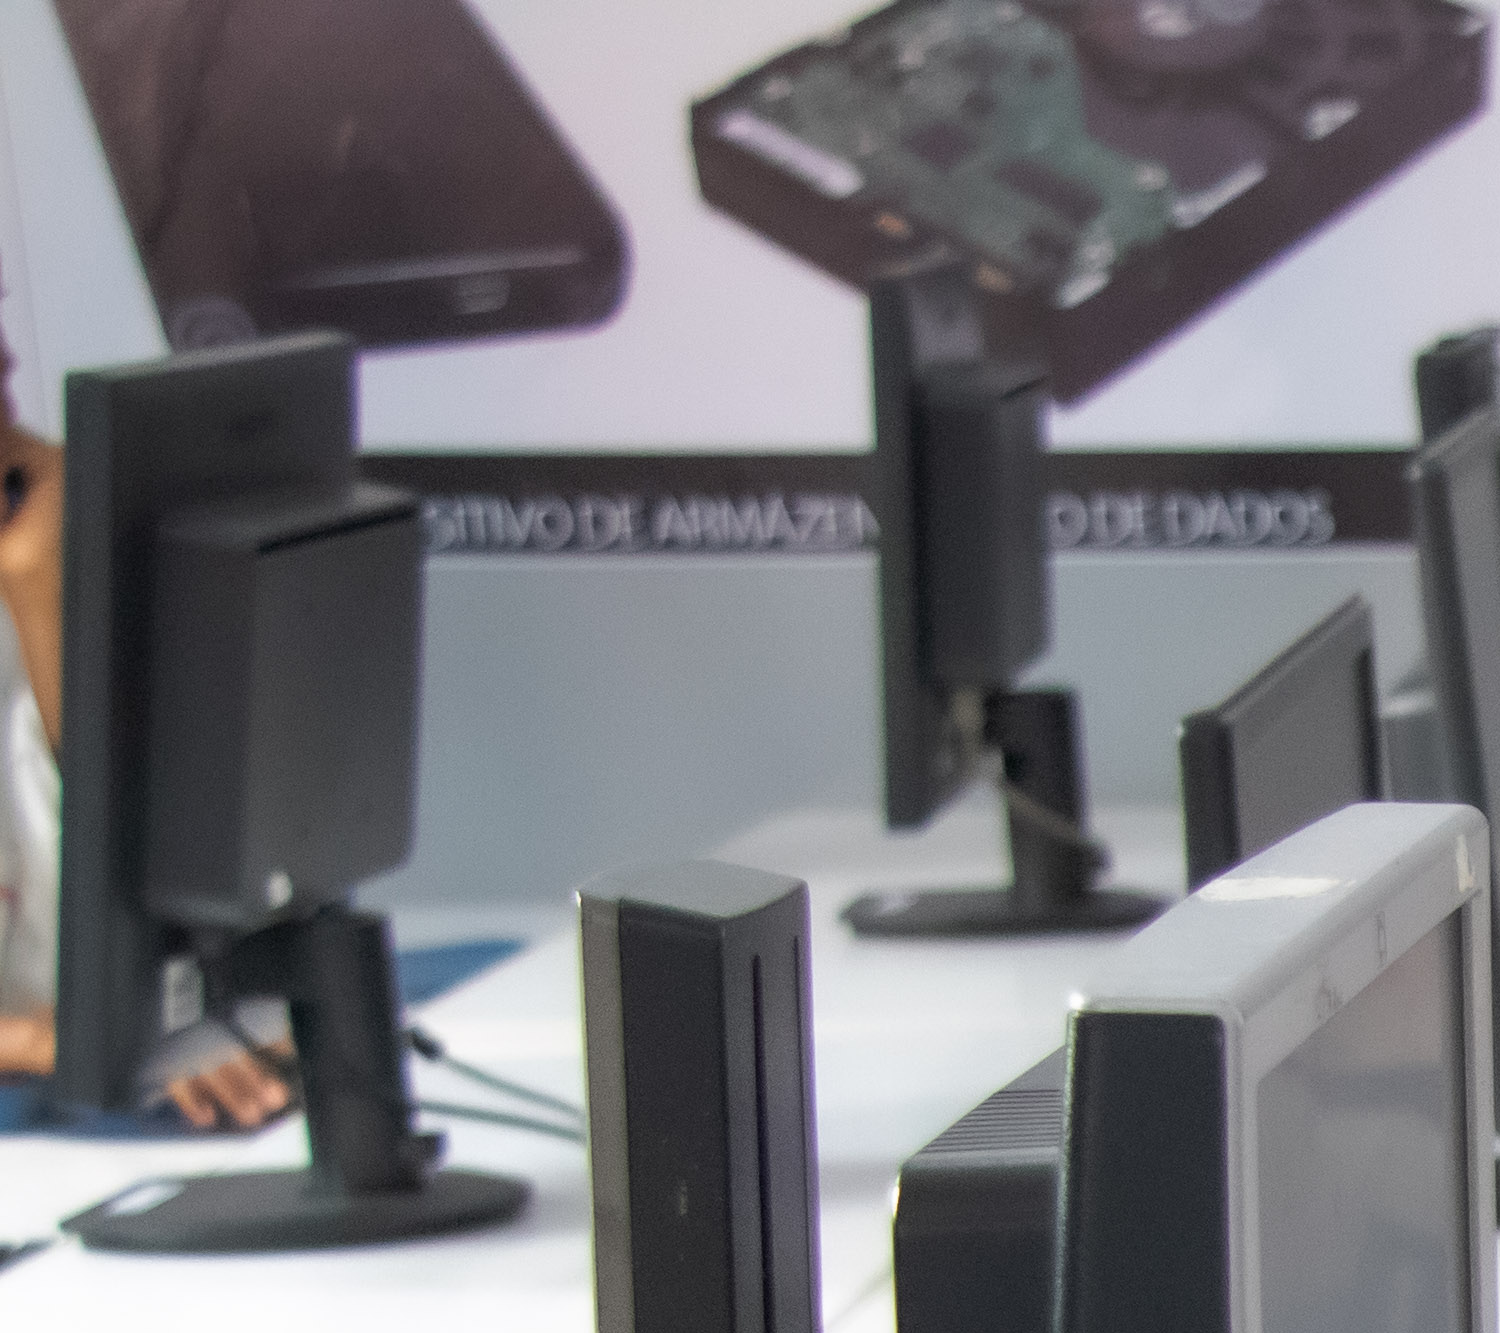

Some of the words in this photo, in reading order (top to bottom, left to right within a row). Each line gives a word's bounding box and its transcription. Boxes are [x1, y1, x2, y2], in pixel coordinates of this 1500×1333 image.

[578, 493, 636, 551] DE
[1090, 491, 1147, 548] DE
[1164, 488, 1336, 548] DADOS
